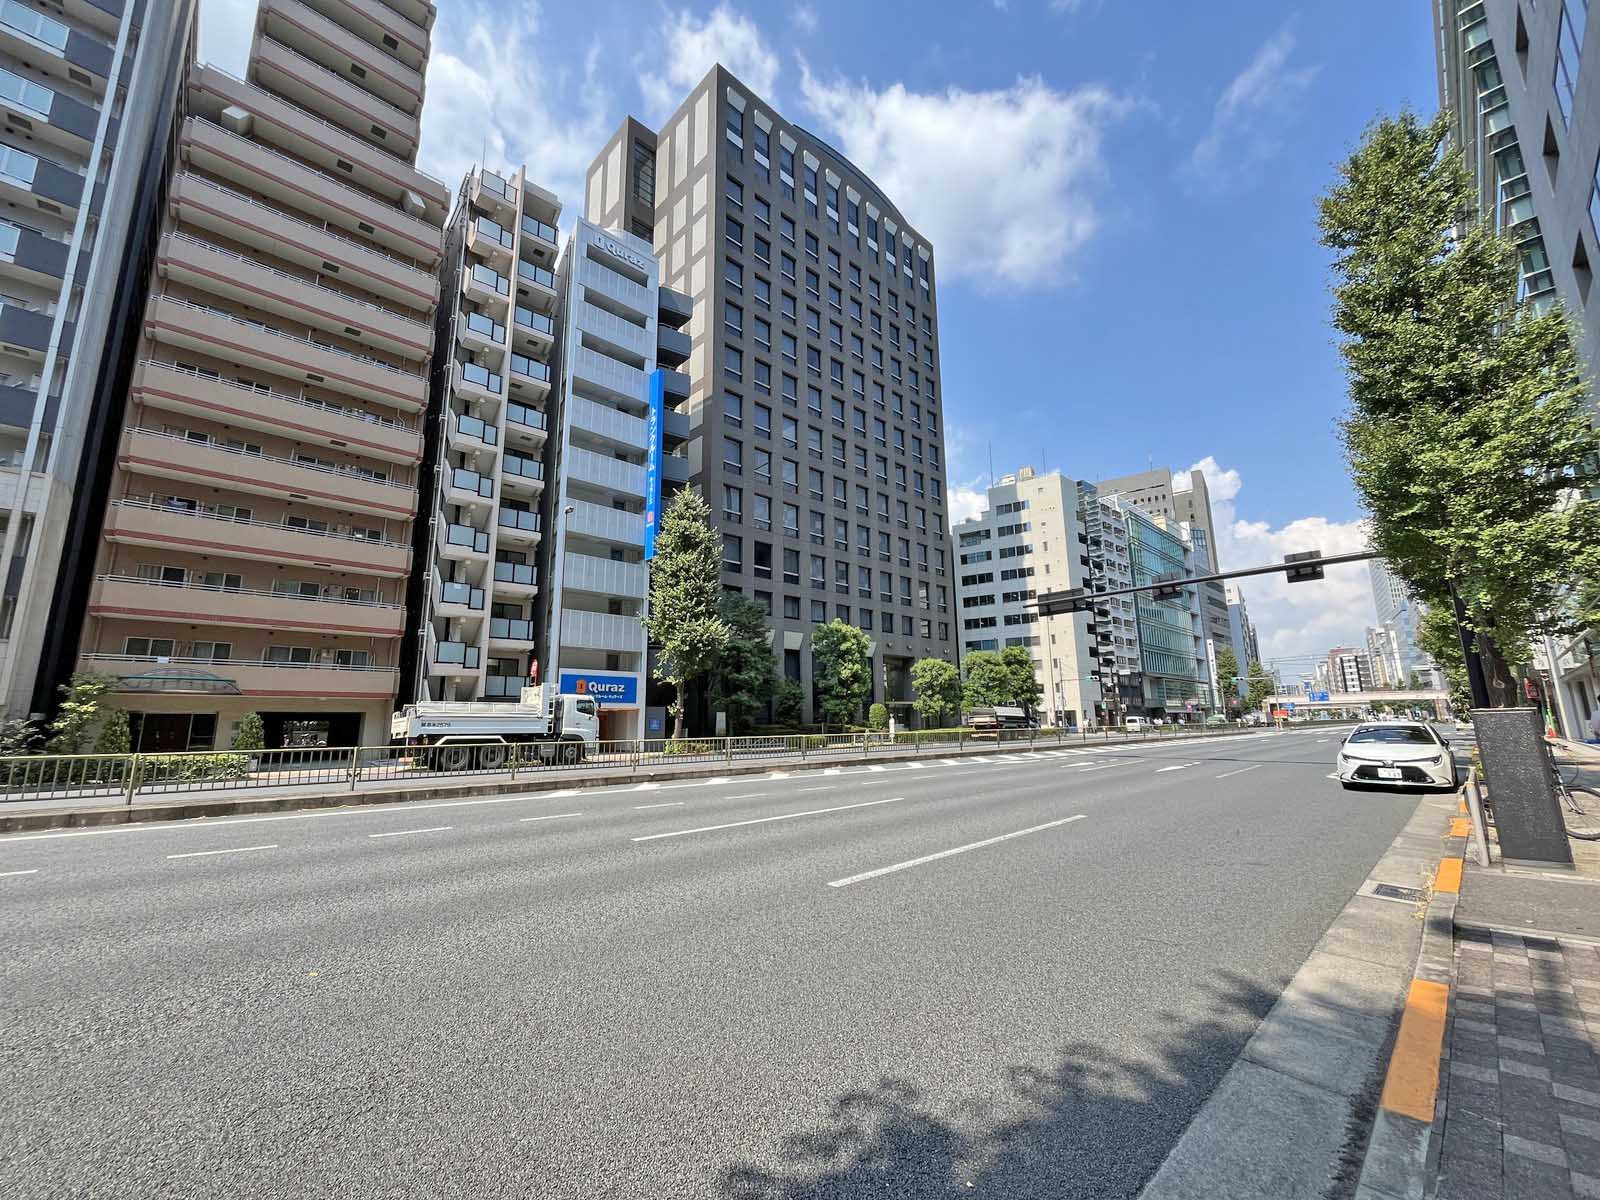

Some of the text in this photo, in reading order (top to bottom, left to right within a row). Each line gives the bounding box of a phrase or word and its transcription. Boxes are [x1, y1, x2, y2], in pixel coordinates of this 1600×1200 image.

[648, 408, 656, 472] トランクルーム
[588, 681, 624, 693] Quraz
